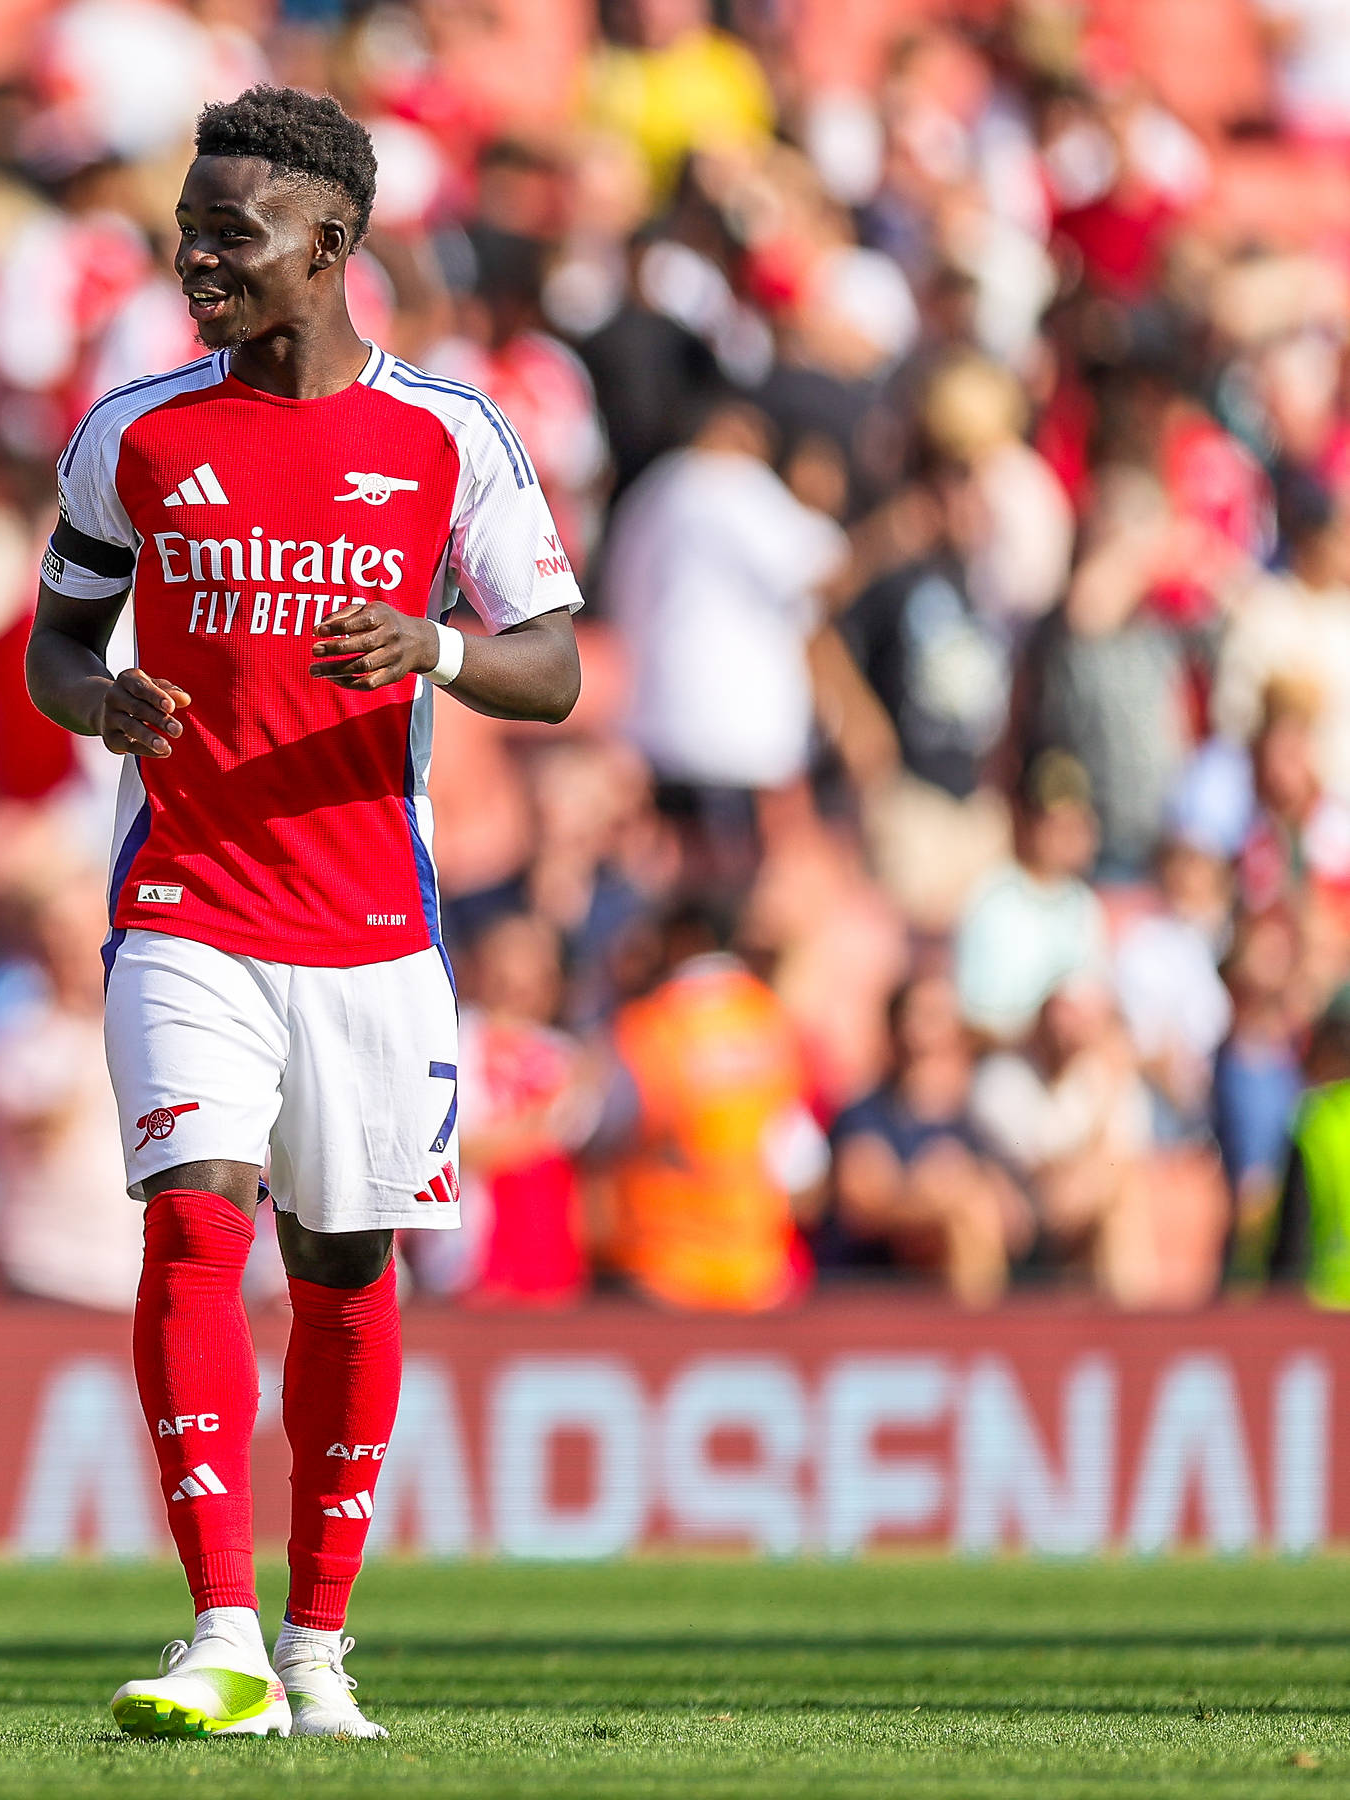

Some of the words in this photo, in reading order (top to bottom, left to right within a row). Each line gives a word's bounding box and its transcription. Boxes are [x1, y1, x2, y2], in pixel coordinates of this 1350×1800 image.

[152, 526, 405, 591] Emirates
[188, 591, 241, 634] FLY
[367, 914, 407, 926] HEAT.RDY
[429, 1061, 458, 1153] 7
[157, 1413, 220, 1438] AFC
[326, 1443, 387, 1461] AFC
